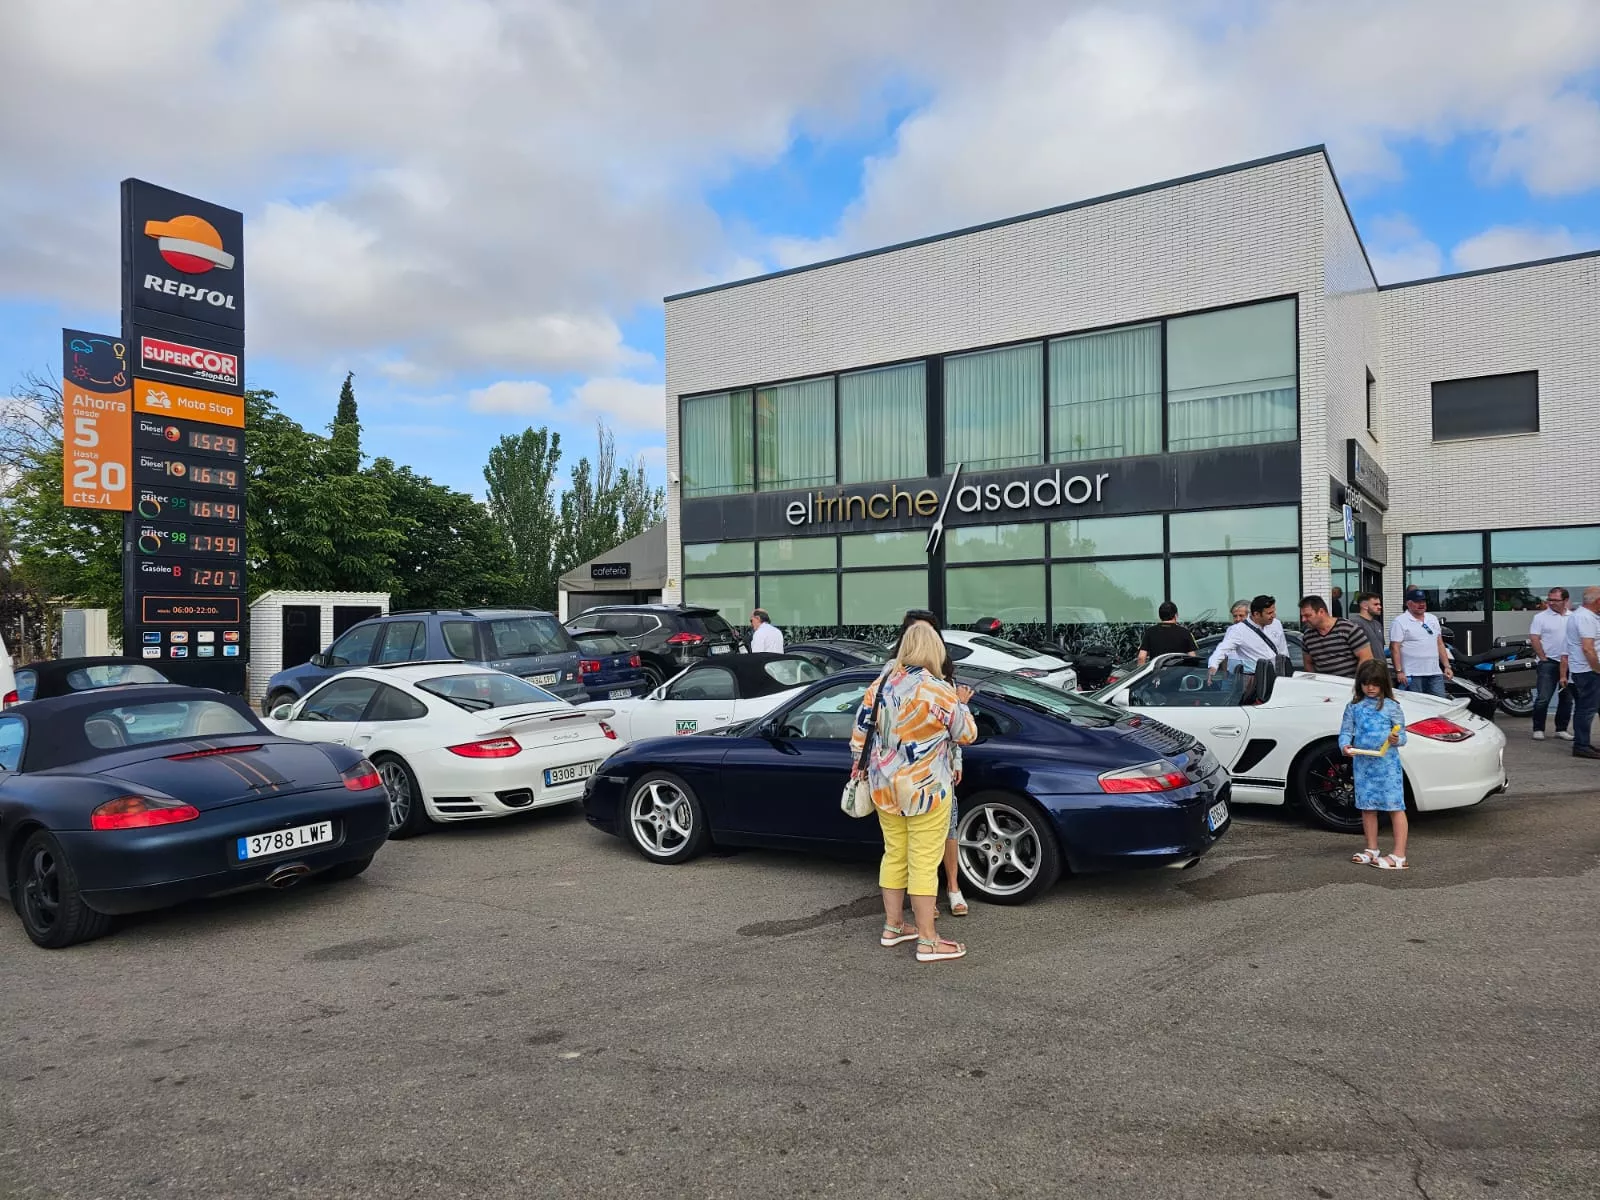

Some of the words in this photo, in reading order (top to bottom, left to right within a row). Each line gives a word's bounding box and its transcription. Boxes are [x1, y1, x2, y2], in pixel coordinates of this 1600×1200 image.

[143, 274, 236, 310] REPSOL
[72, 394, 126, 412] Ahorra
[178, 397, 206, 410] Moto
[209, 402, 234, 417] Stop
[73, 408, 100, 418] Desde
[73, 418, 99, 448] 5
[140, 423, 164, 433] Diesel
[73, 450, 100, 460] Hasta
[140, 459, 164, 469] Diesel
[73, 460, 126, 492] 20
[956, 468, 1110, 513] asador
[141, 493, 169, 504] efitec
[171, 497, 187, 509] 95
[141, 529, 169, 539] efitec
[171, 532, 187, 544] 98
[173, 566, 182, 577] B
[678, 721, 696, 730] TAG
[552, 767, 575, 781] 9308
[252, 831, 294, 854] 3788
[300, 824, 328, 844] LWF
